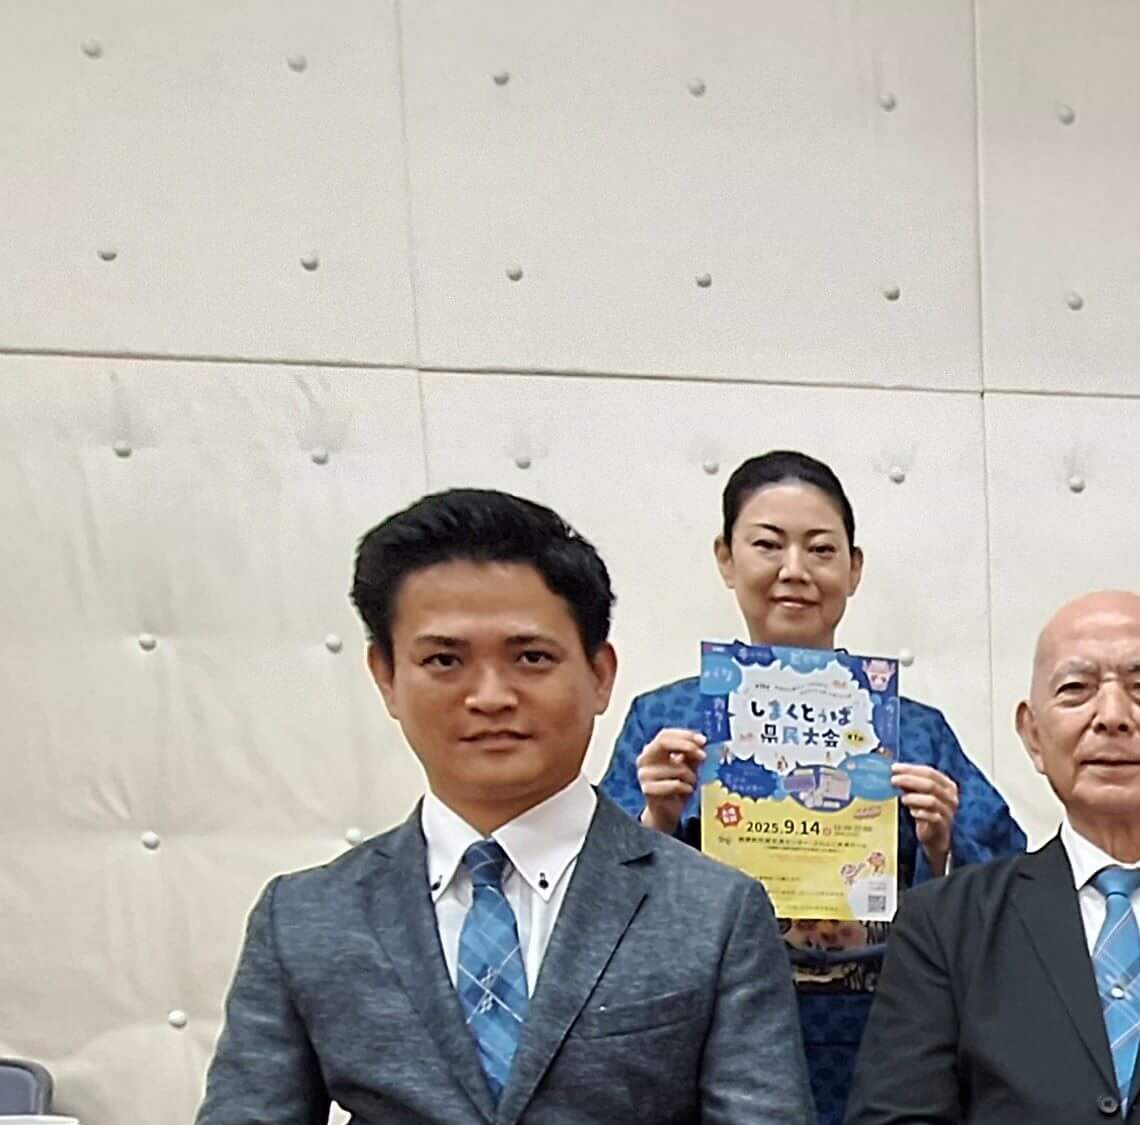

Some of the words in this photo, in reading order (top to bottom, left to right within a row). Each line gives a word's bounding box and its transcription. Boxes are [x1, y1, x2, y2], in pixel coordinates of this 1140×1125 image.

[751, 699, 853, 726] しまくとぅば
[761, 723, 840, 748] 県民大会
[746, 819, 820, 836] 2025.9.14
